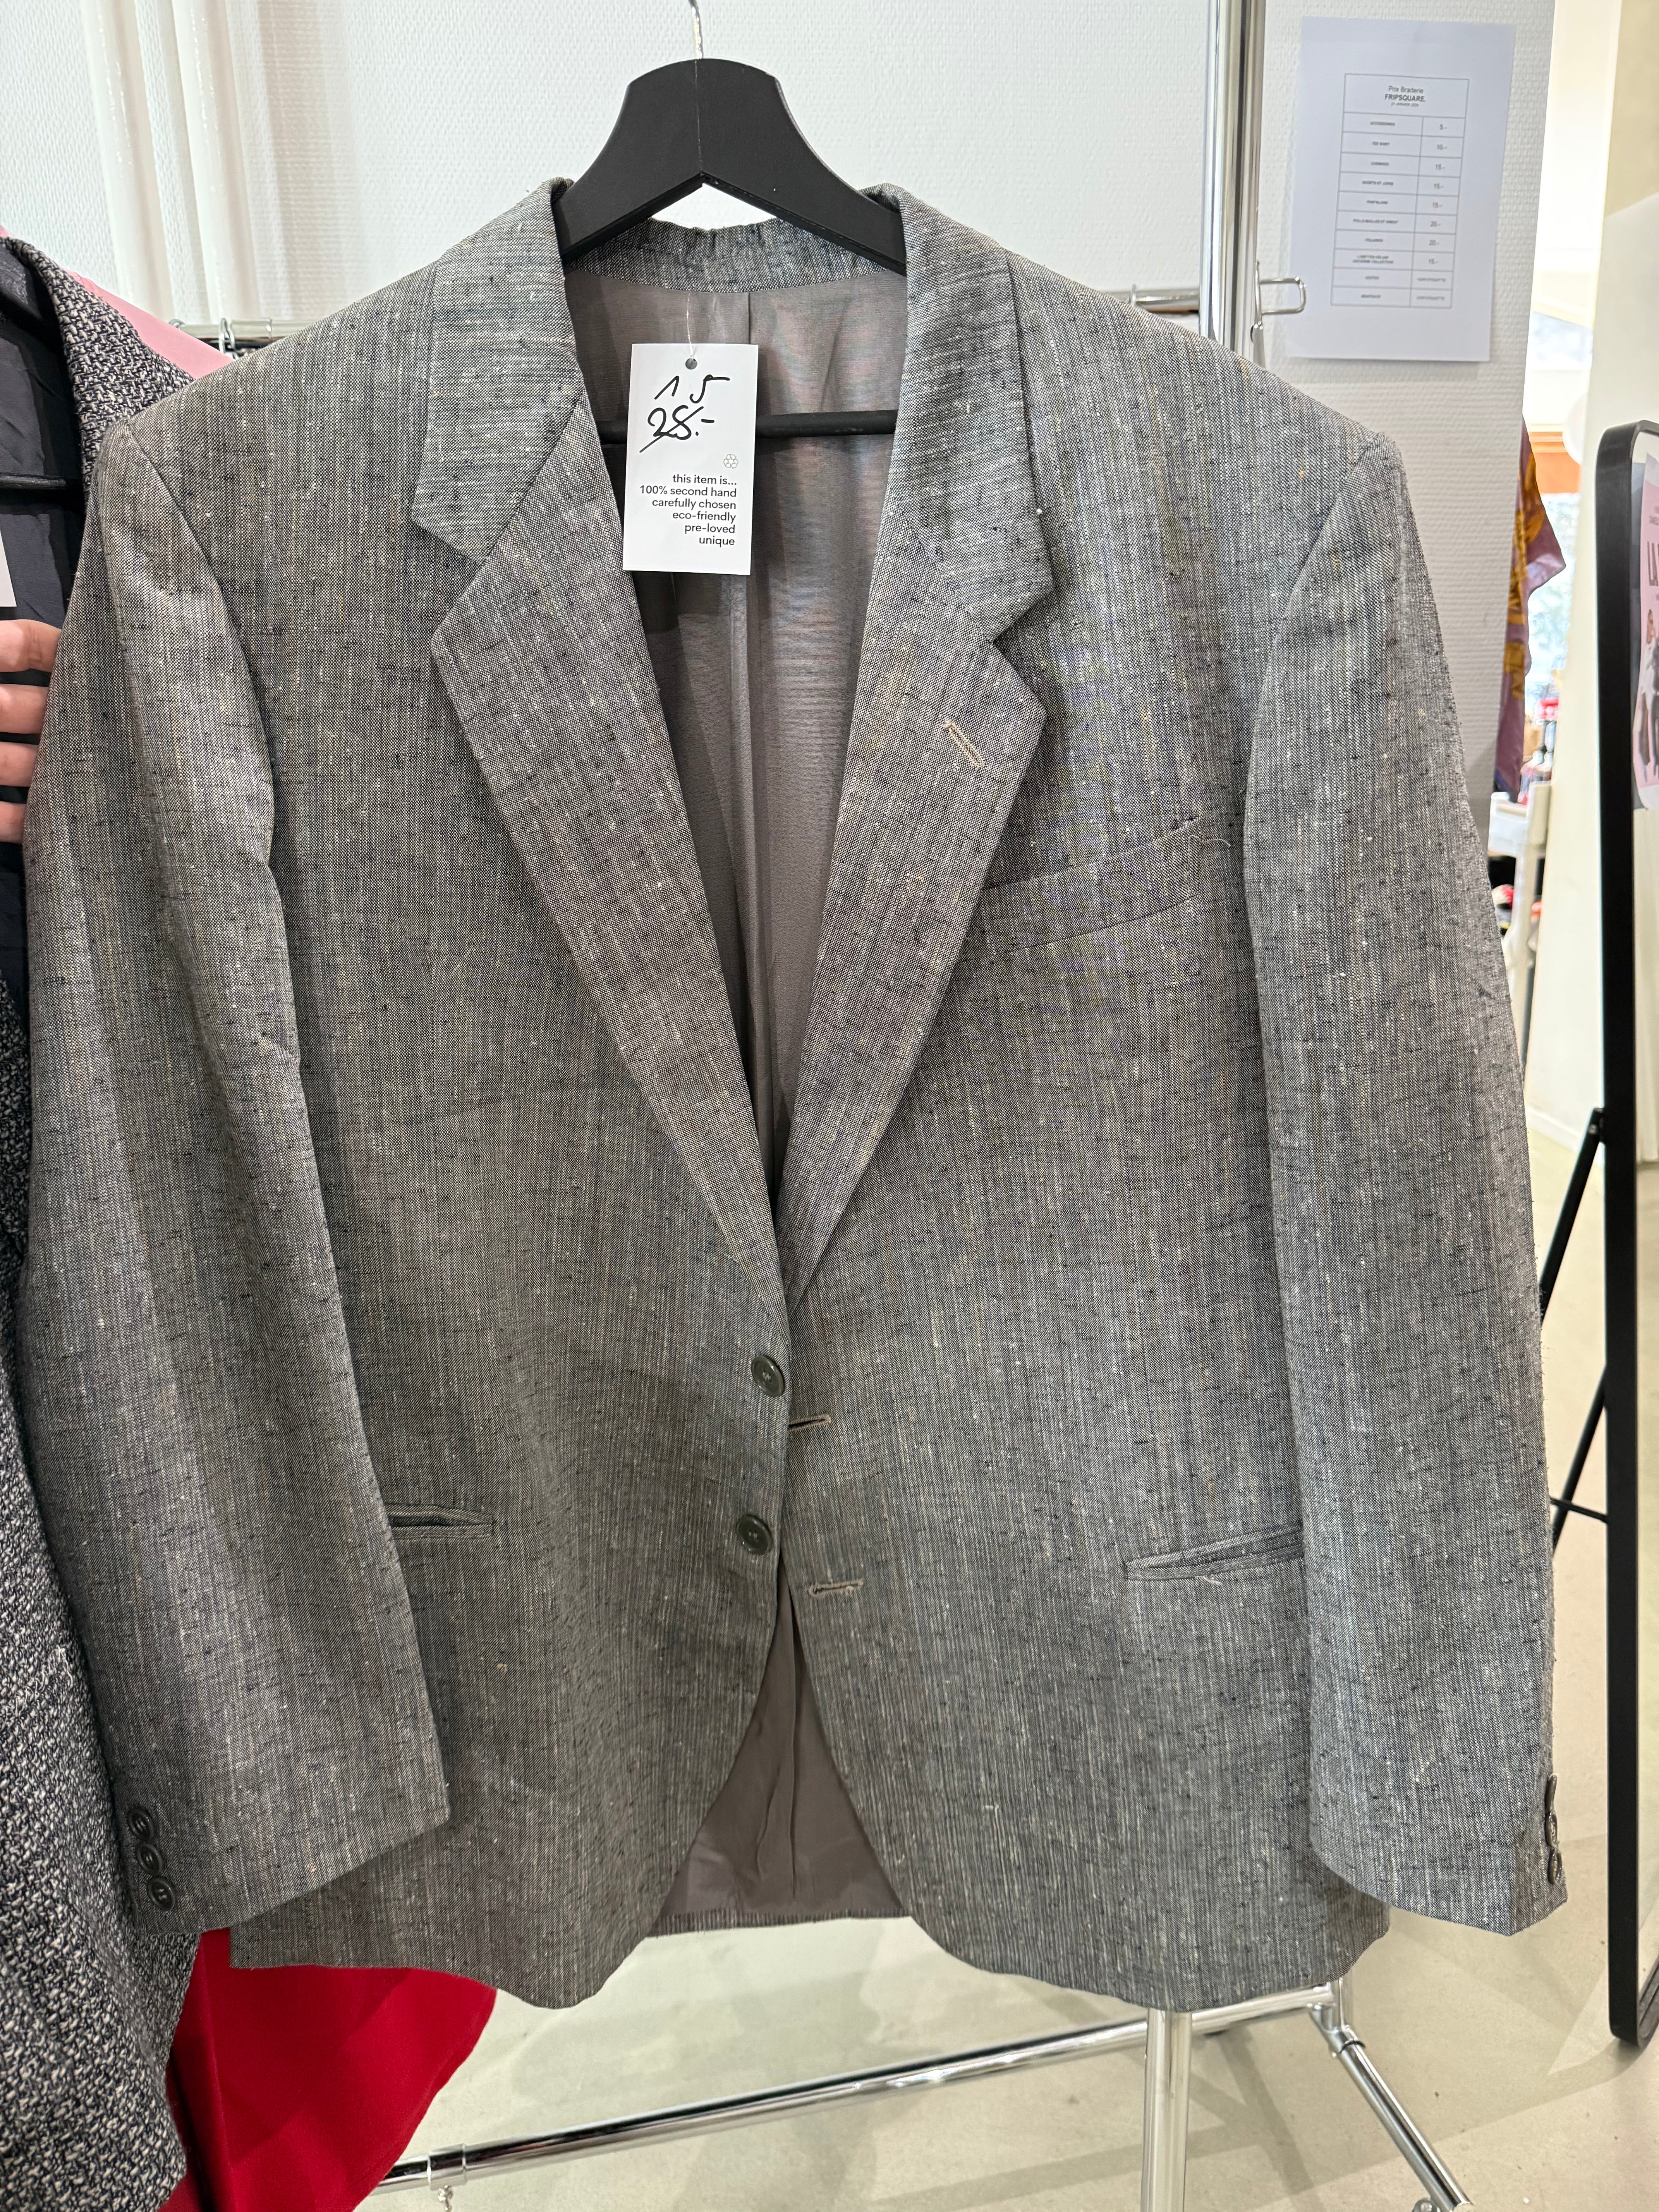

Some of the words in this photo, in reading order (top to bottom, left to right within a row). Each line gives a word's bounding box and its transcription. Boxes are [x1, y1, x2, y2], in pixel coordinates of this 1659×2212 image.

[673, 474, 691, 483] this
[694, 475, 716, 484] item
[720, 476, 736, 485] is...
[641, 485, 667, 494] 100%
[670, 487, 708, 495] second
[711, 487, 736, 497] hand
[653, 498, 696, 510] carefully
[699, 499, 736, 509] chosen
[673, 511, 736, 524] eco-friendly
[685, 523, 735, 534] pre-loved
[699, 536, 735, 547] unique
